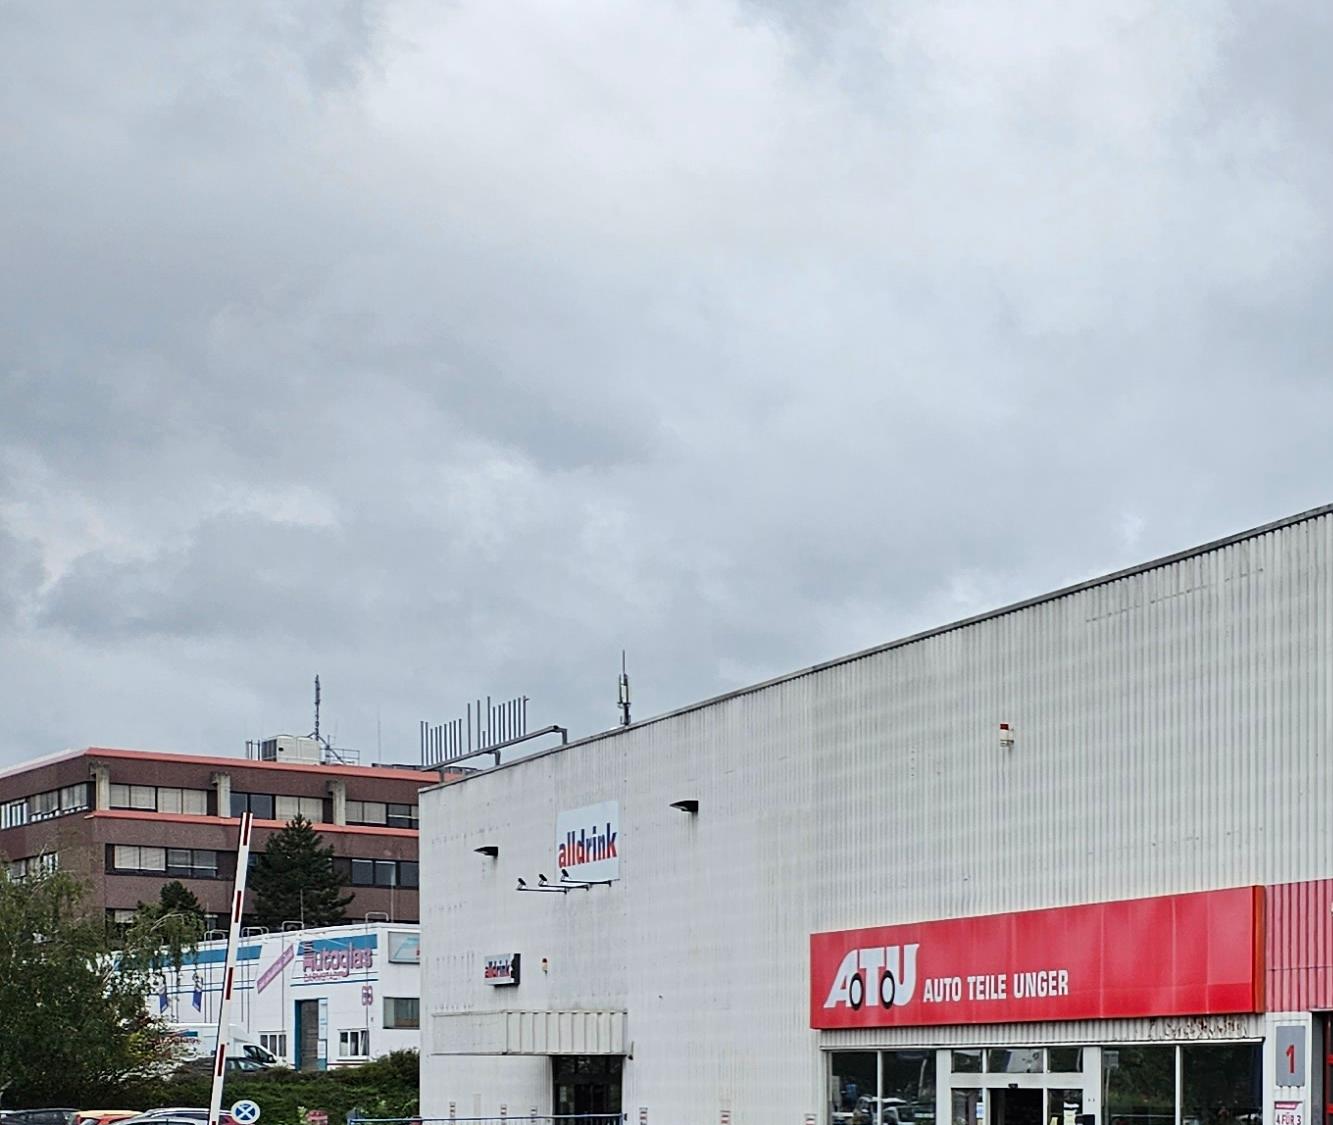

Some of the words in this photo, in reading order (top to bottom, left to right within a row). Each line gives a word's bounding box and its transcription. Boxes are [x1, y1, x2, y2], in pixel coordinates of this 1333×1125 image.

[558, 823, 617, 868] alldrink
[485, 960, 511, 979] alldrink
[923, 977, 962, 1003] AUTO
[967, 974, 1007, 1001] TEILE
[1013, 969, 1069, 998] UNGER
[1286, 1045, 1295, 1073] 1
[1296, 1114, 1302, 1125] 3
